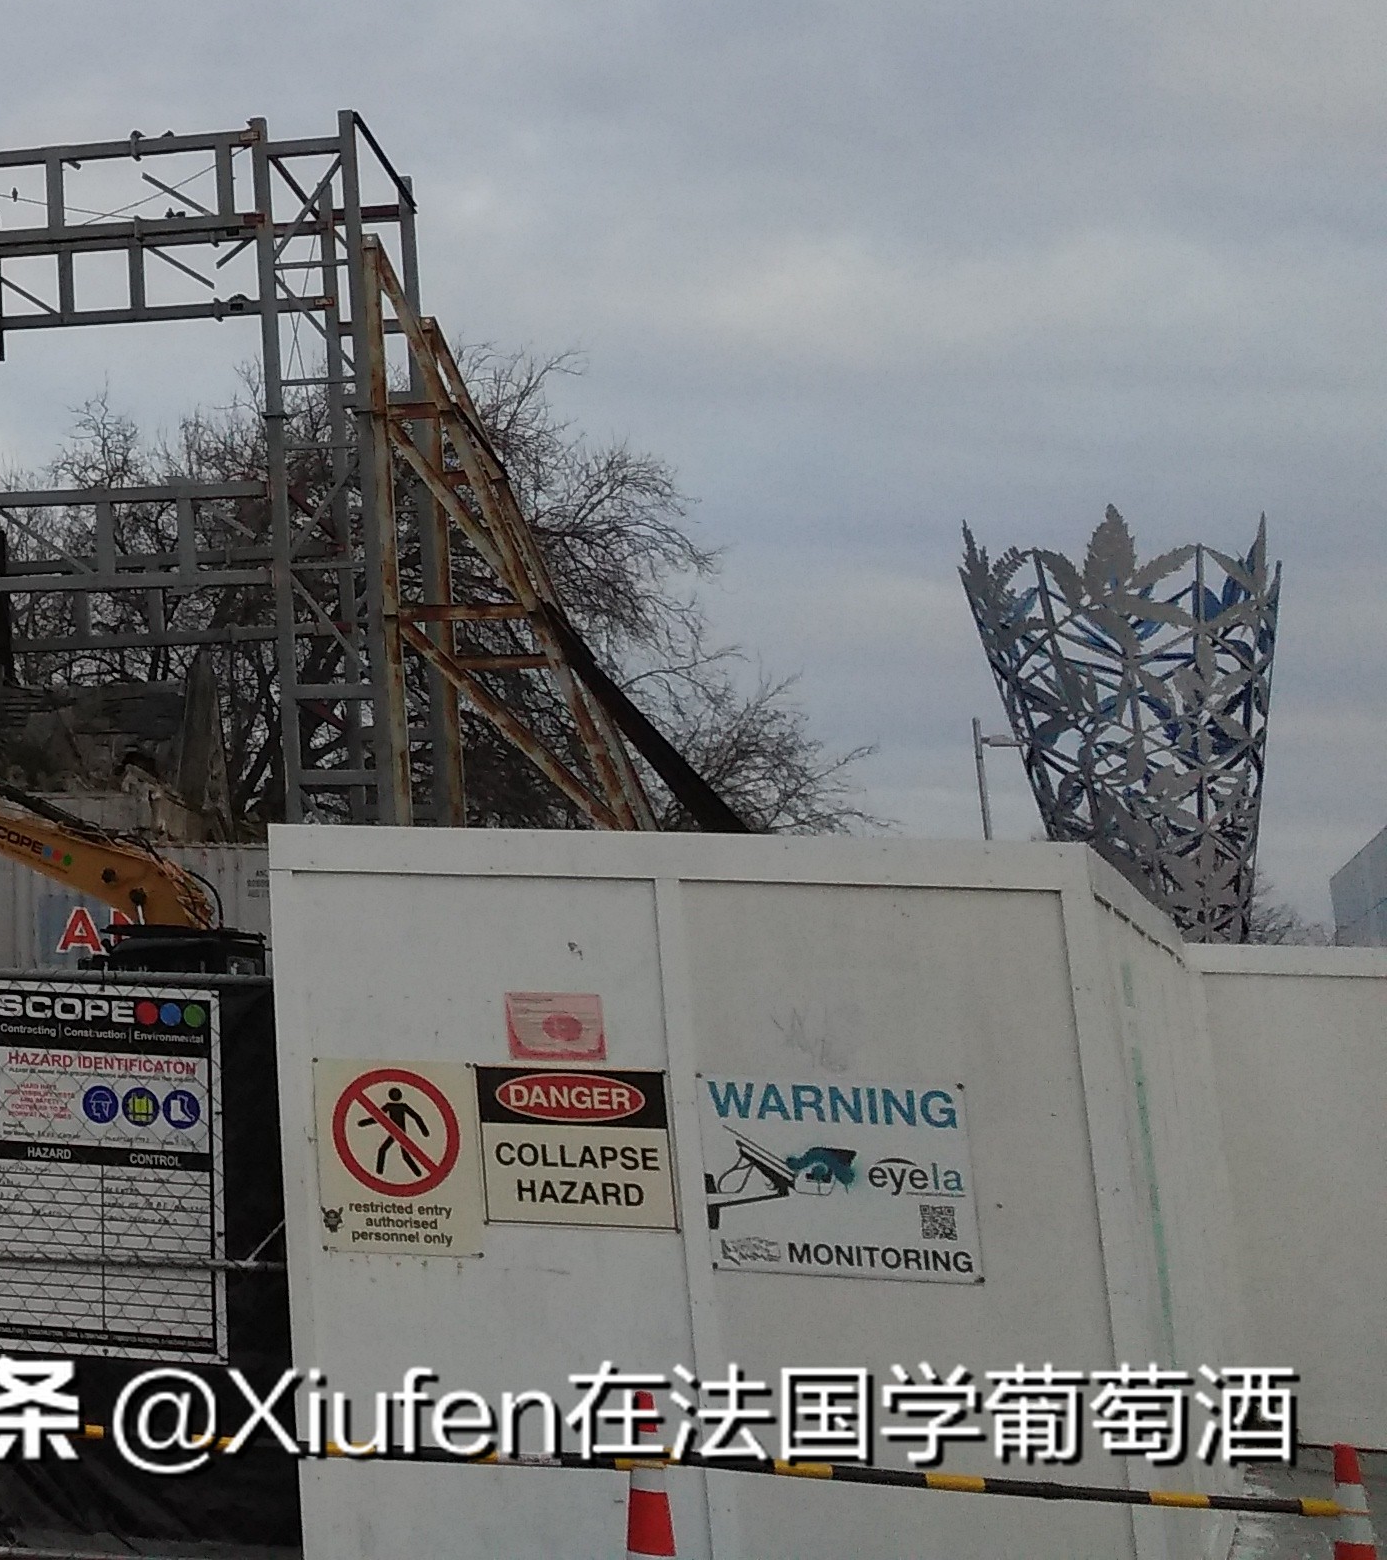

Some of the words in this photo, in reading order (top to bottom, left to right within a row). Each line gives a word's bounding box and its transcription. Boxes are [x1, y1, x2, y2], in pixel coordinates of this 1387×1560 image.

[0, 1023, 57, 1038] Contracting
[63, 1026, 127, 1040] Construction
[133, 1030, 205, 1044] Environmental
[7, 1051, 74, 1068] HAZARD
[508, 1084, 631, 1110] DANGER
[706, 1080, 959, 1129] WARNING
[27, 1146, 72, 1160] HAZARD
[129, 1153, 182, 1167] CONTROL
[494, 1141, 661, 1172] COLLAPSE
[867, 1157, 964, 1196] eyela
[516, 1178, 645, 1207] HAZARD
[348, 1201, 414, 1215] restricted
[417, 1204, 453, 1219] entry
[364, 1216, 439, 1230] authorised
[351, 1229, 420, 1243] personnel
[423, 1232, 454, 1247] only
[787, 1241, 975, 1274] MONITORING
